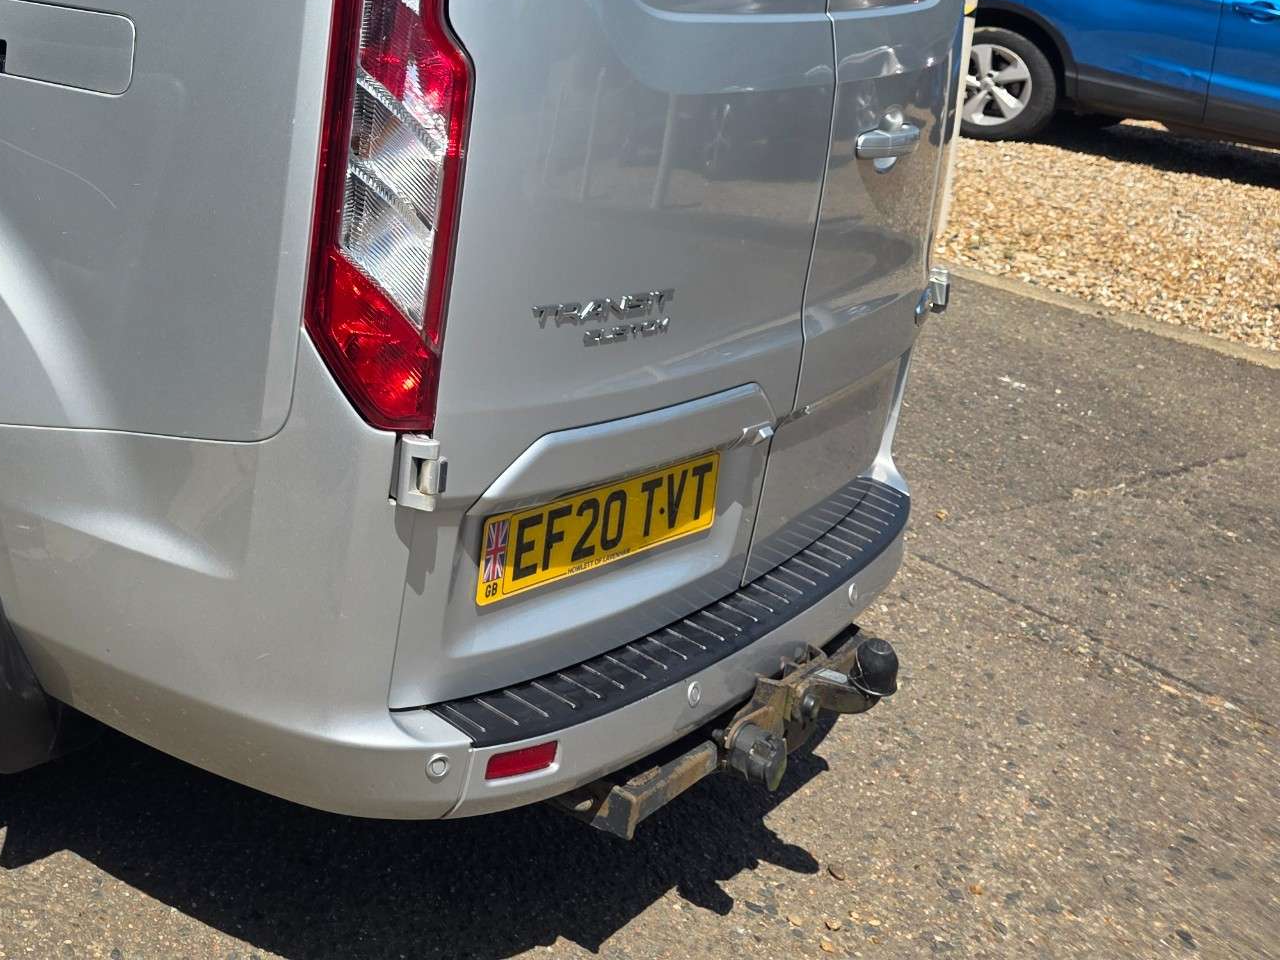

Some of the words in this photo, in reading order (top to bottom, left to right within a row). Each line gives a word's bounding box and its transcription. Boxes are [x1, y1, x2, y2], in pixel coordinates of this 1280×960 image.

[531, 289, 675, 329] TRANSIT
[512, 491, 627, 581] EF20
[641, 462, 713, 537] TVT
[484, 581, 499, 599] GB
